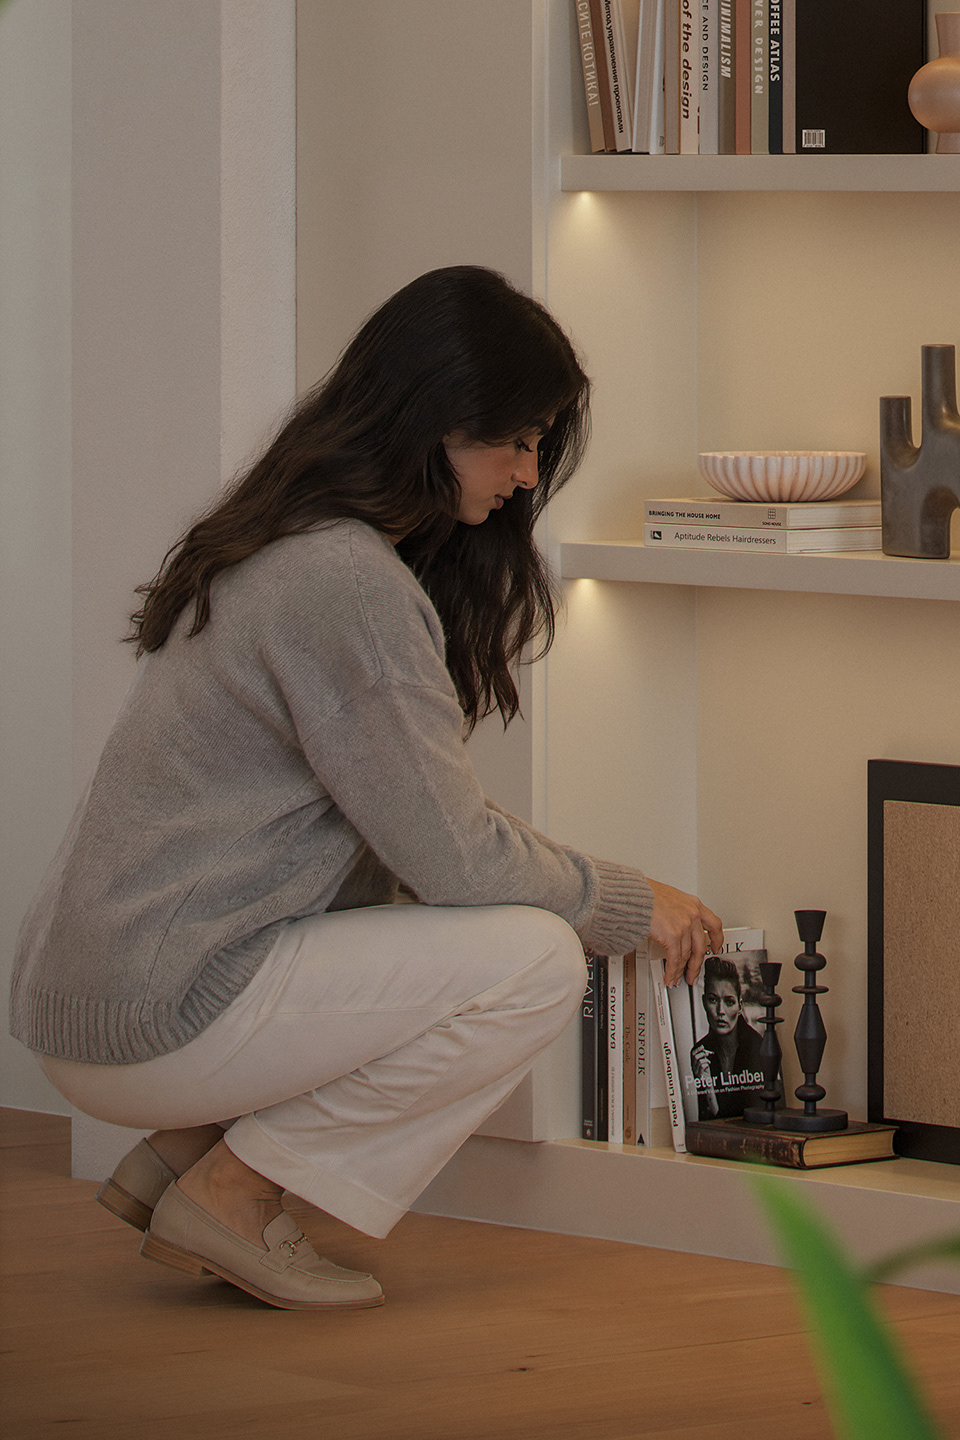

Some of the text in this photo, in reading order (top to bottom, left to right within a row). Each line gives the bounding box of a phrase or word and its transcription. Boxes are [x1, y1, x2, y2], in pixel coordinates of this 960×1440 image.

[682, 21, 692, 51] the
[701, 16, 709, 41] AND
[583, 41, 599, 108] КОТИКА!
[606, 24, 619, 84] управления
[613, 85, 624, 134] проектами
[701, 47, 709, 91] DESIGN
[754, 37, 764, 95] DESIGN
[770, 38, 780, 82] ATLAS
[680, 58, 692, 119] design
[648, 510, 675, 518] BRINGING
[674, 532, 777, 545] Aptitude Rebels Hairdressers
[663, 1042, 679, 1128] Peter Lindbergh
[685, 1075, 718, 1090] Peter
